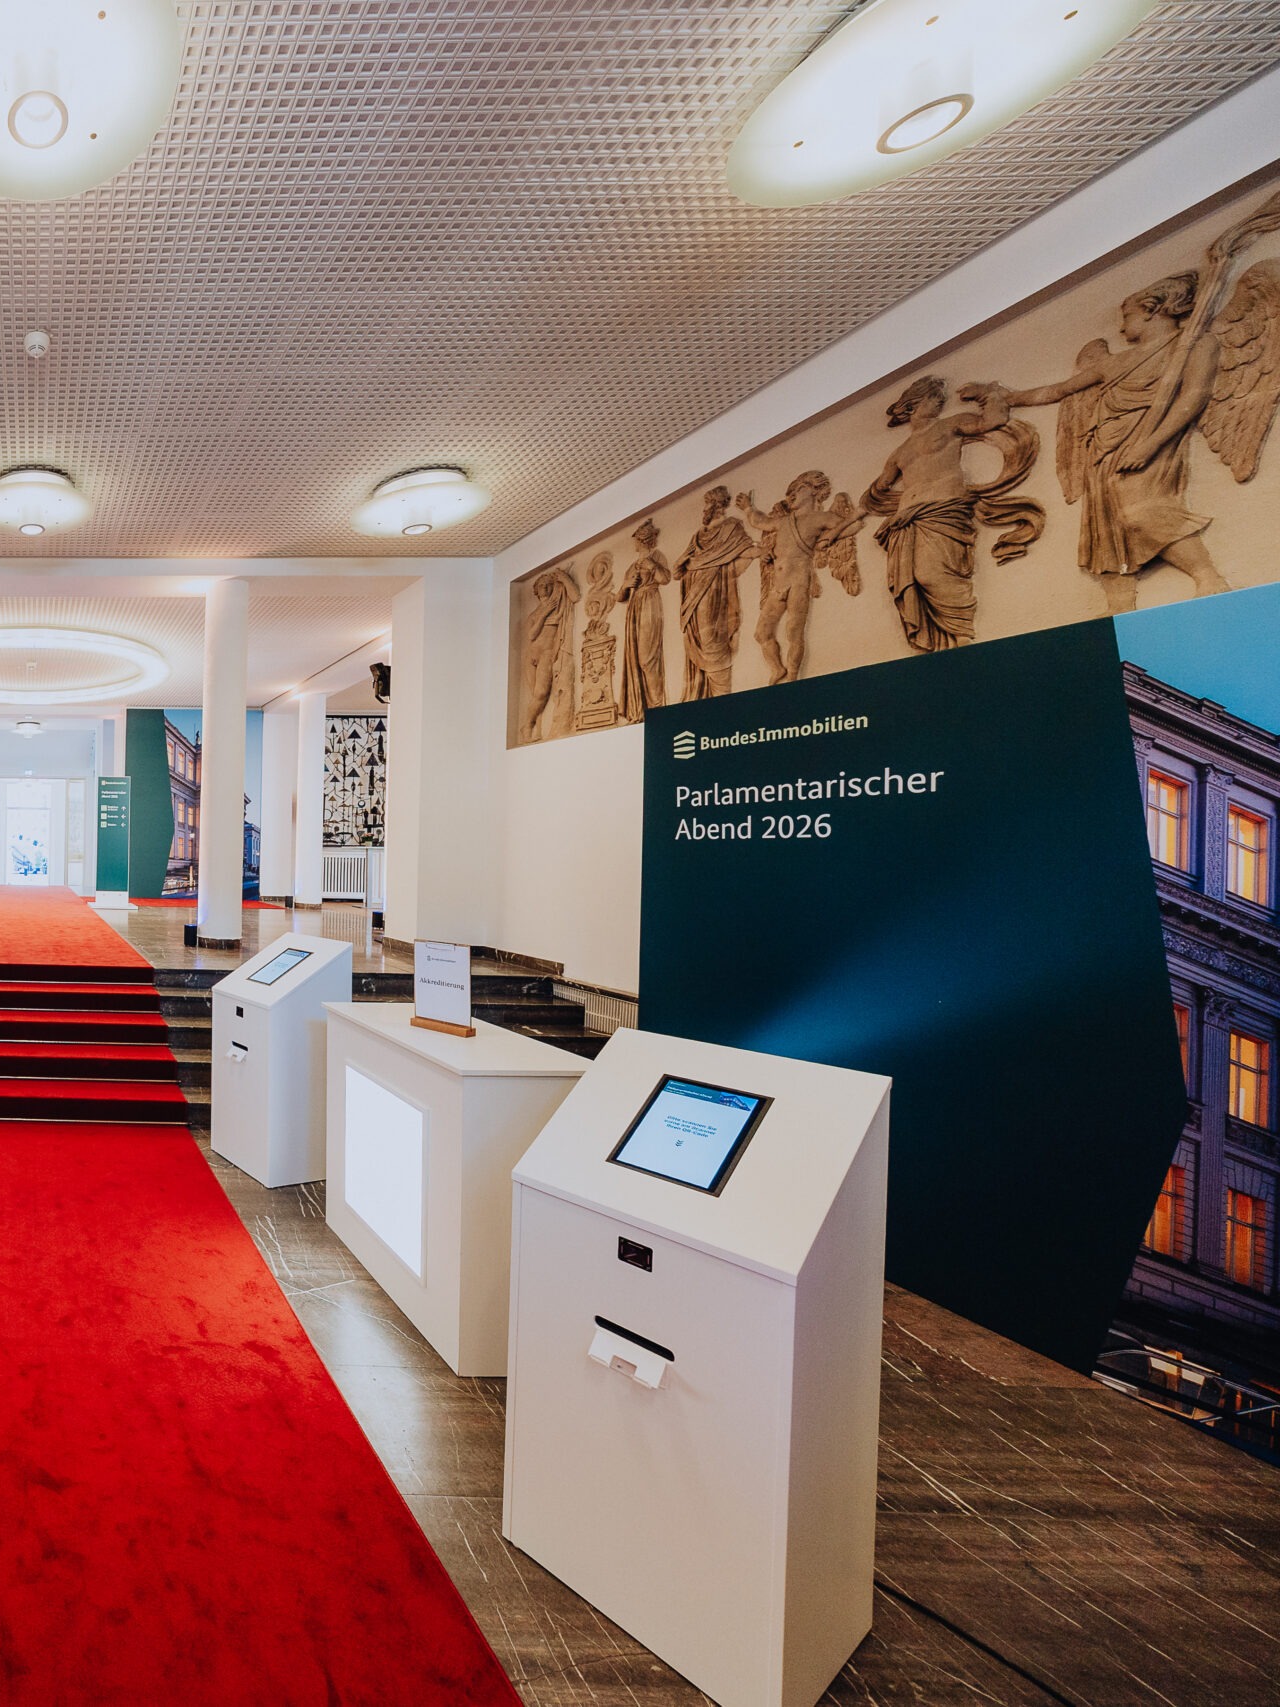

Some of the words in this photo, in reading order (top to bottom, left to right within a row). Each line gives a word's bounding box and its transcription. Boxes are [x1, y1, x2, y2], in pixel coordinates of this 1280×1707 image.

[700, 714, 869, 751] BundesImmobilien
[676, 766, 945, 808] Parlamentarischer
[675, 815, 752, 841] Abend
[761, 813, 832, 839] 2026
[419, 977, 465, 990] Akkreditierung
